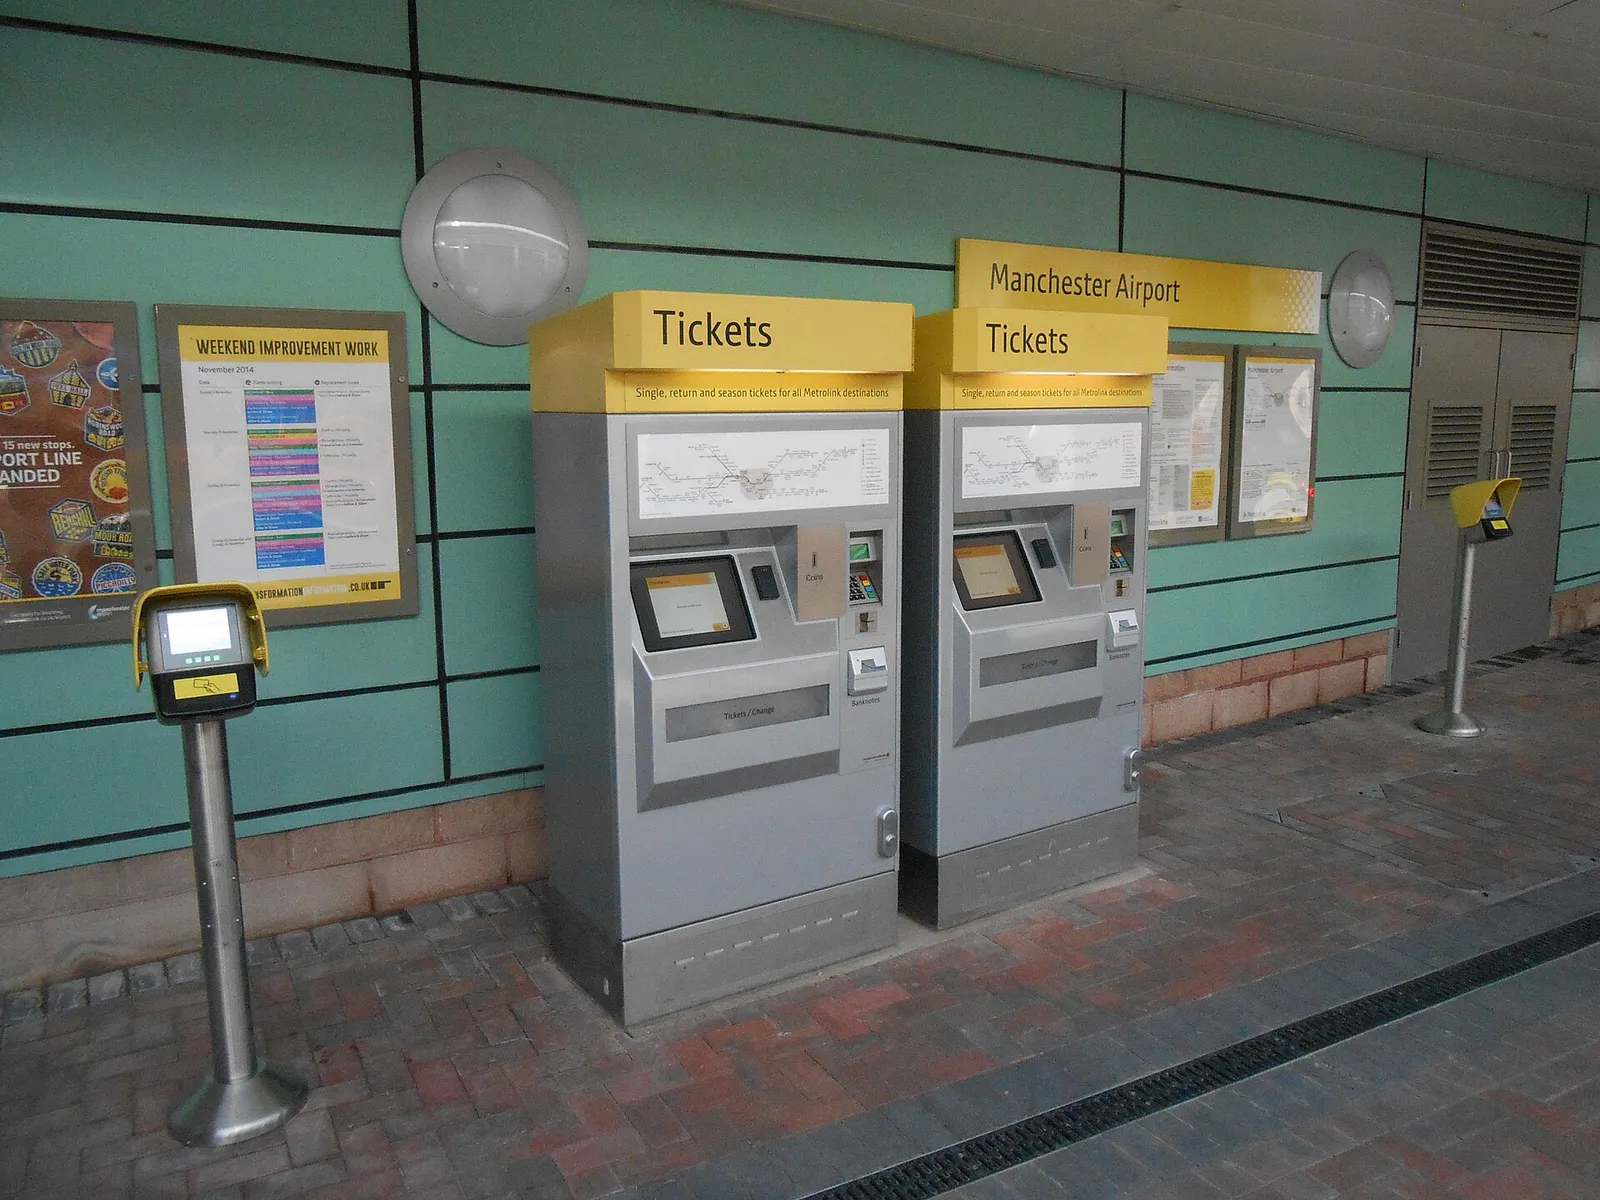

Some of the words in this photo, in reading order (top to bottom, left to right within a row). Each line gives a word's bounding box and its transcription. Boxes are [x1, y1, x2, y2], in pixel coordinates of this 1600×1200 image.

[990, 262, 1111, 298] Manchester
[1115, 274, 1181, 307] Airport
[653, 309, 773, 347] Tickets
[985, 322, 1069, 354] Tickets
[196, 339, 255, 355] WEEKEND
[259, 340, 342, 356] IMPROVEMENT
[344, 341, 379, 357] WORK
[198, 366, 235, 374] November
[236, 366, 254, 374] 2014
[636, 387, 667, 400] Single,
[669, 388, 698, 398] return
[699, 388, 716, 398] and
[718, 389, 747, 398] season
[749, 387, 777, 398] tickets
[779, 387, 790, 398] for
[792, 387, 802, 398] all
[803, 387, 841, 398] Metrolink
[842, 387, 889, 398] destinations
[962, 388, 985, 400] Single,
[985, 389, 1006, 398] return
[1006, 388, 1019, 397] and
[1019, 389, 1041, 397] season
[1042, 388, 1062, 397] tickets
[1063, 388, 1072, 397] for
[1072, 388, 1080, 397] all
[1080, 388, 1107, 397] Metrolink
[1108, 388, 1143, 397] destinations
[3, 441, 15, 450] 15
[17, 442, 40, 450] new
[42, 441, 75, 451] stops.
[0, 453, 39, 467] ORT
[44, 451, 83, 466] LINE
[805, 573, 823, 582] Coins
[1108, 652, 1130, 660] Banknotes
[851, 697, 880, 707] Banknotes
[724, 709, 747, 720] Tickets
[751, 706, 776, 717] Change
